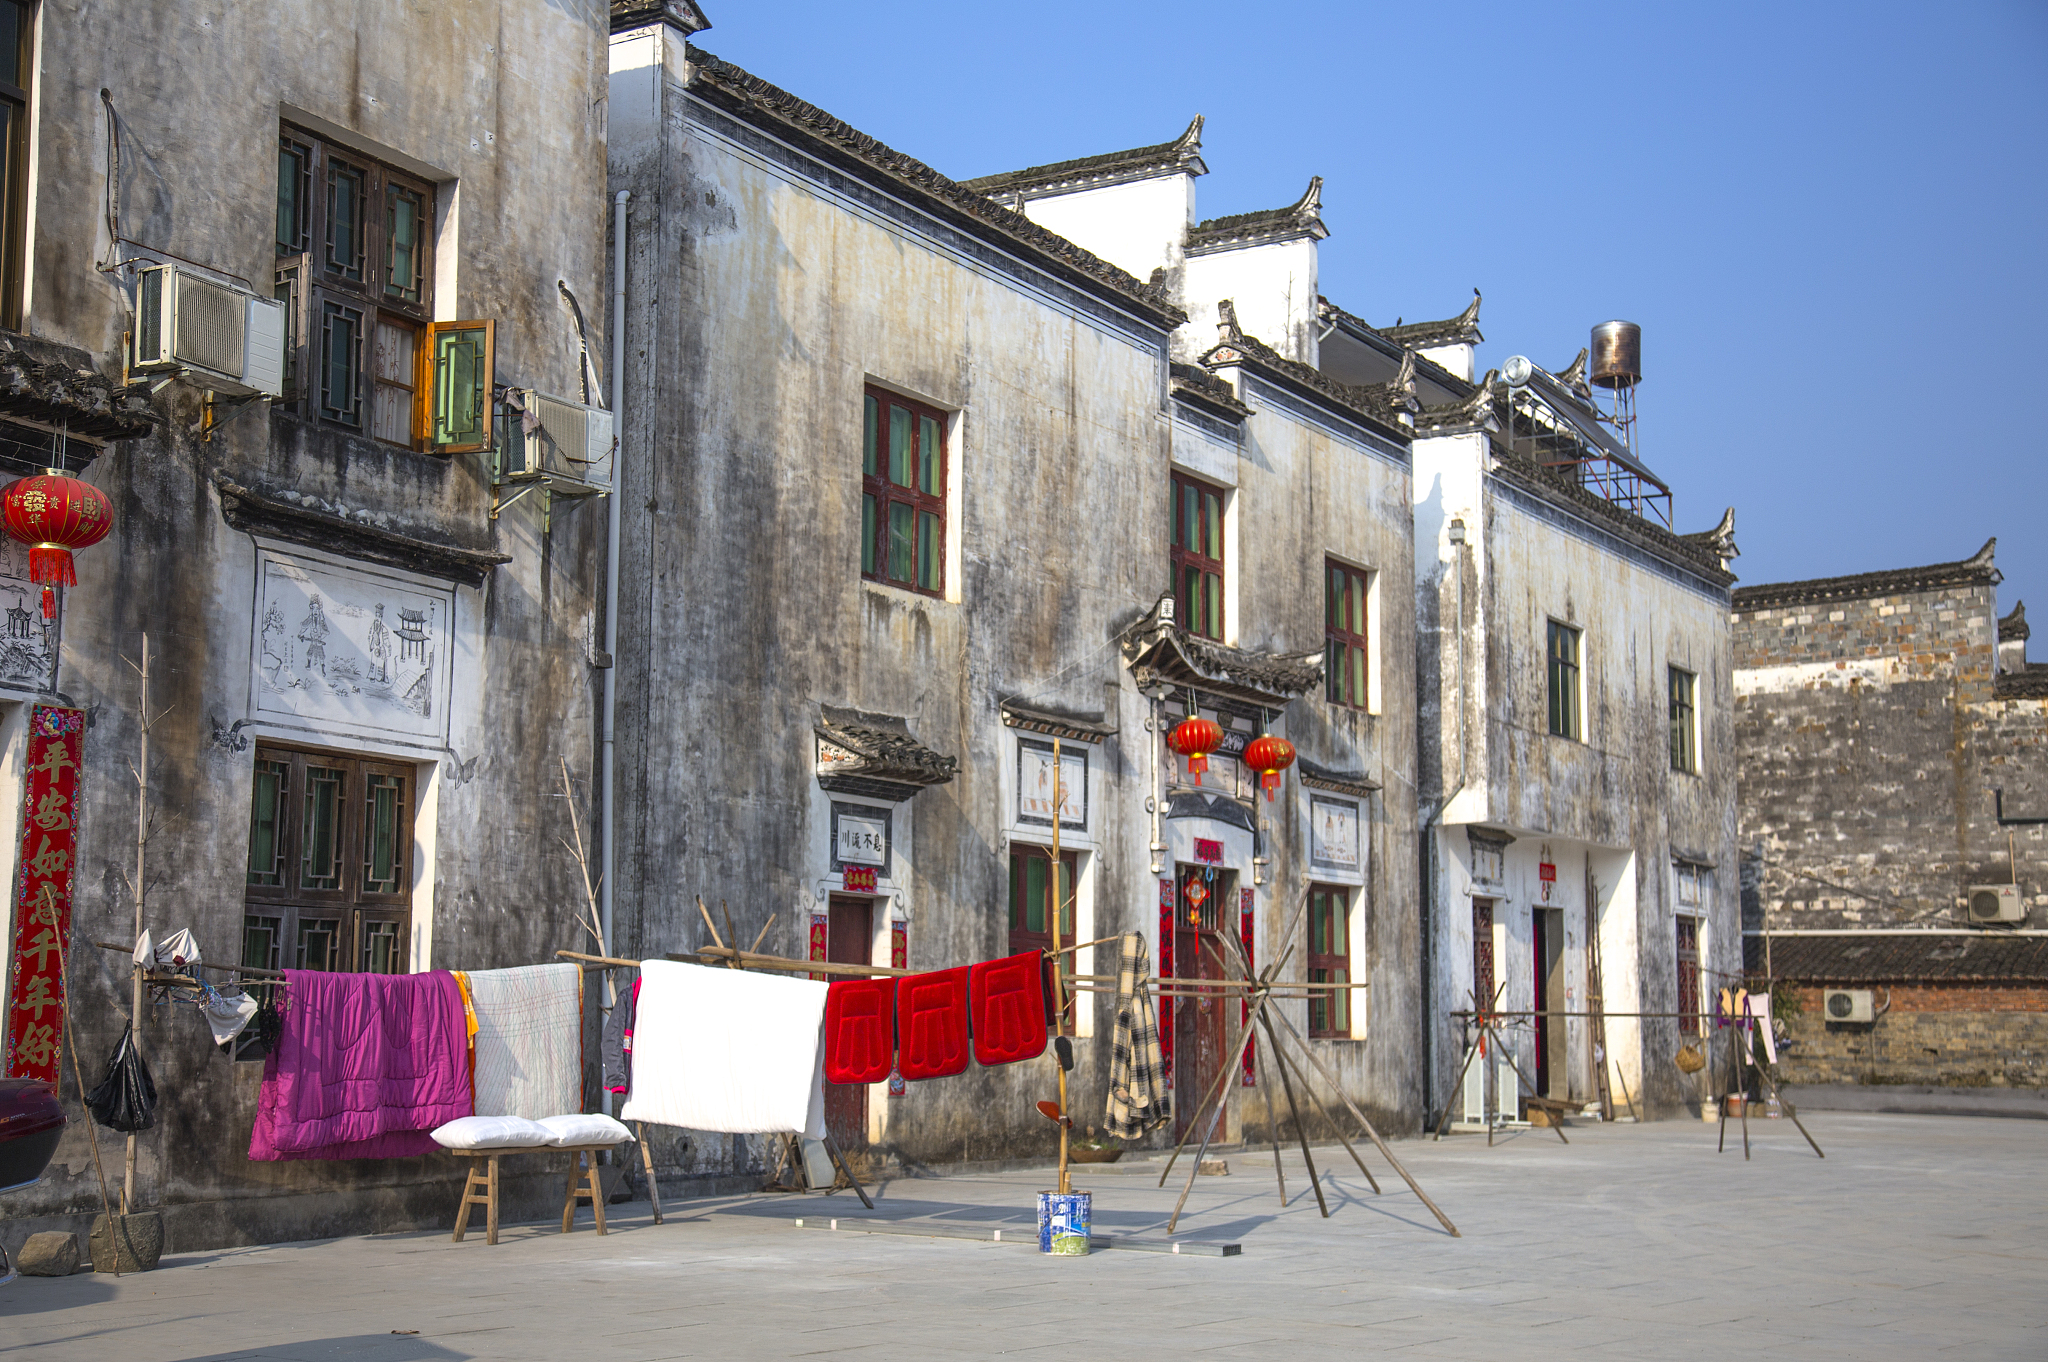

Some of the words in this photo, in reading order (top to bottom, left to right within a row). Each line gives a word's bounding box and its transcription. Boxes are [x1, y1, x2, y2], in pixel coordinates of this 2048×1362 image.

[17, 743, 75, 1067] 平安如意千年好
[841, 829, 882, 852] 川流不息
